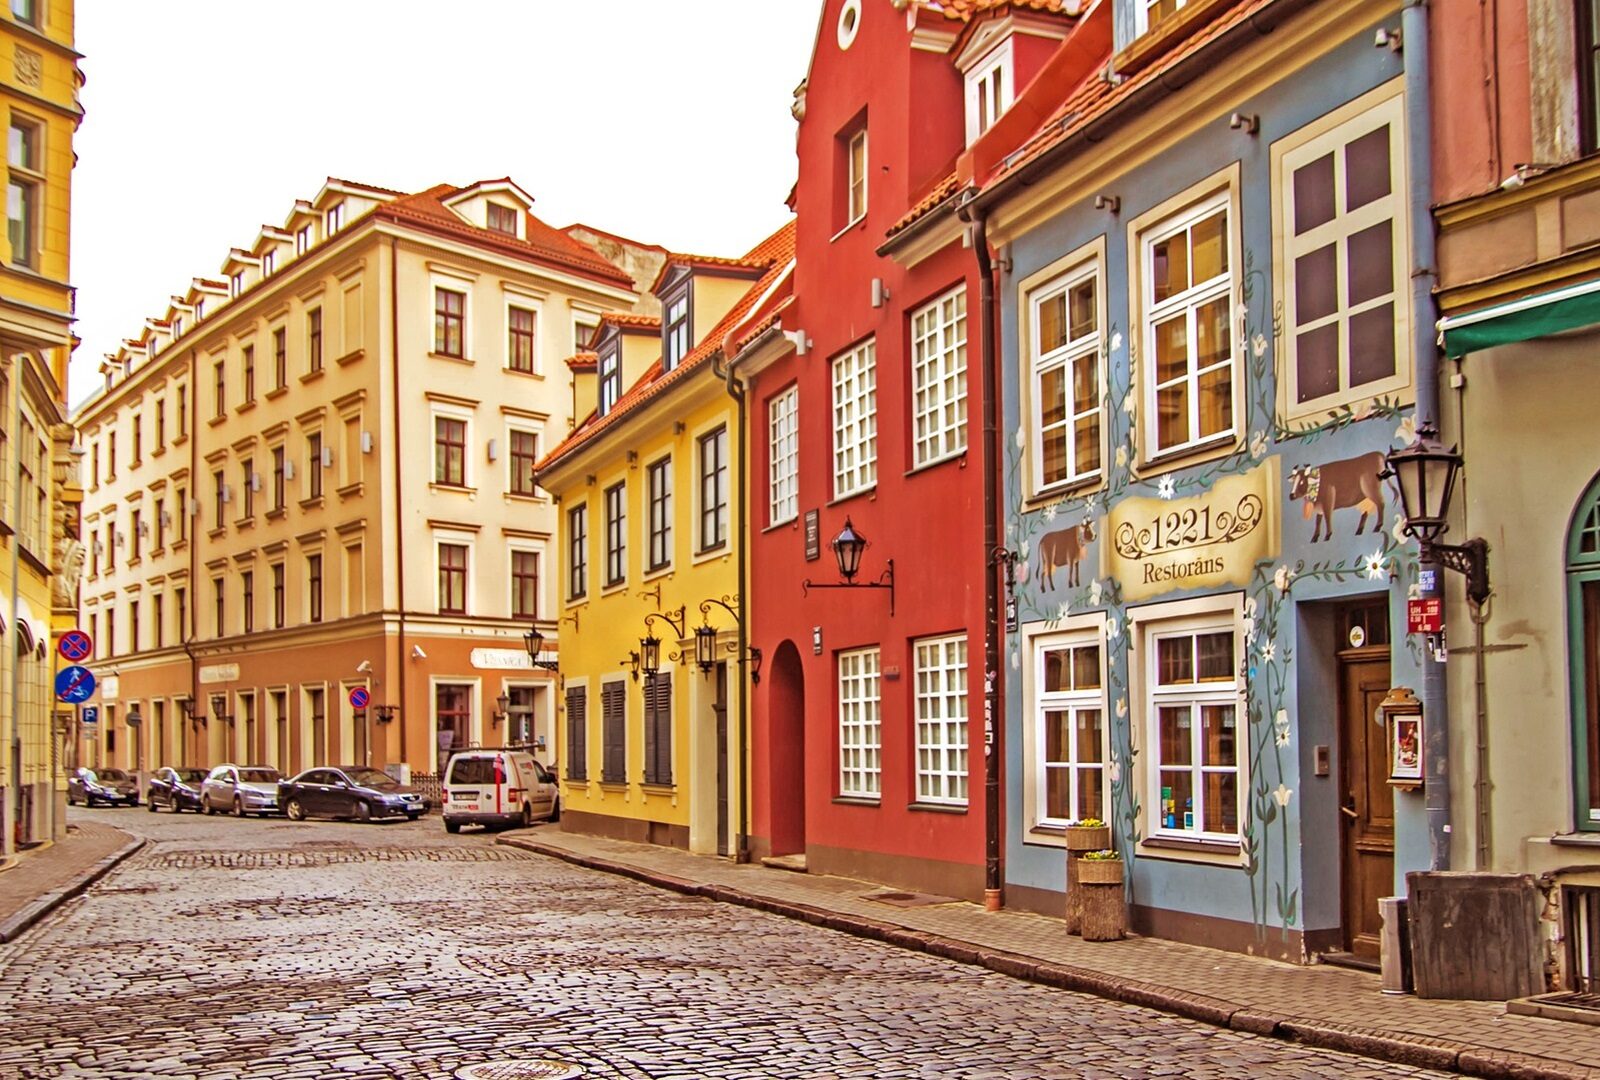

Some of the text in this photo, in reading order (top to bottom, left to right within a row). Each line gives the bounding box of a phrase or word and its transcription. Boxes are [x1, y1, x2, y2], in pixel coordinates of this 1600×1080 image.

[1151, 505, 1214, 551] 1221
[1142, 556, 1225, 585] Restorāns
[84, 709, 96, 721] P
